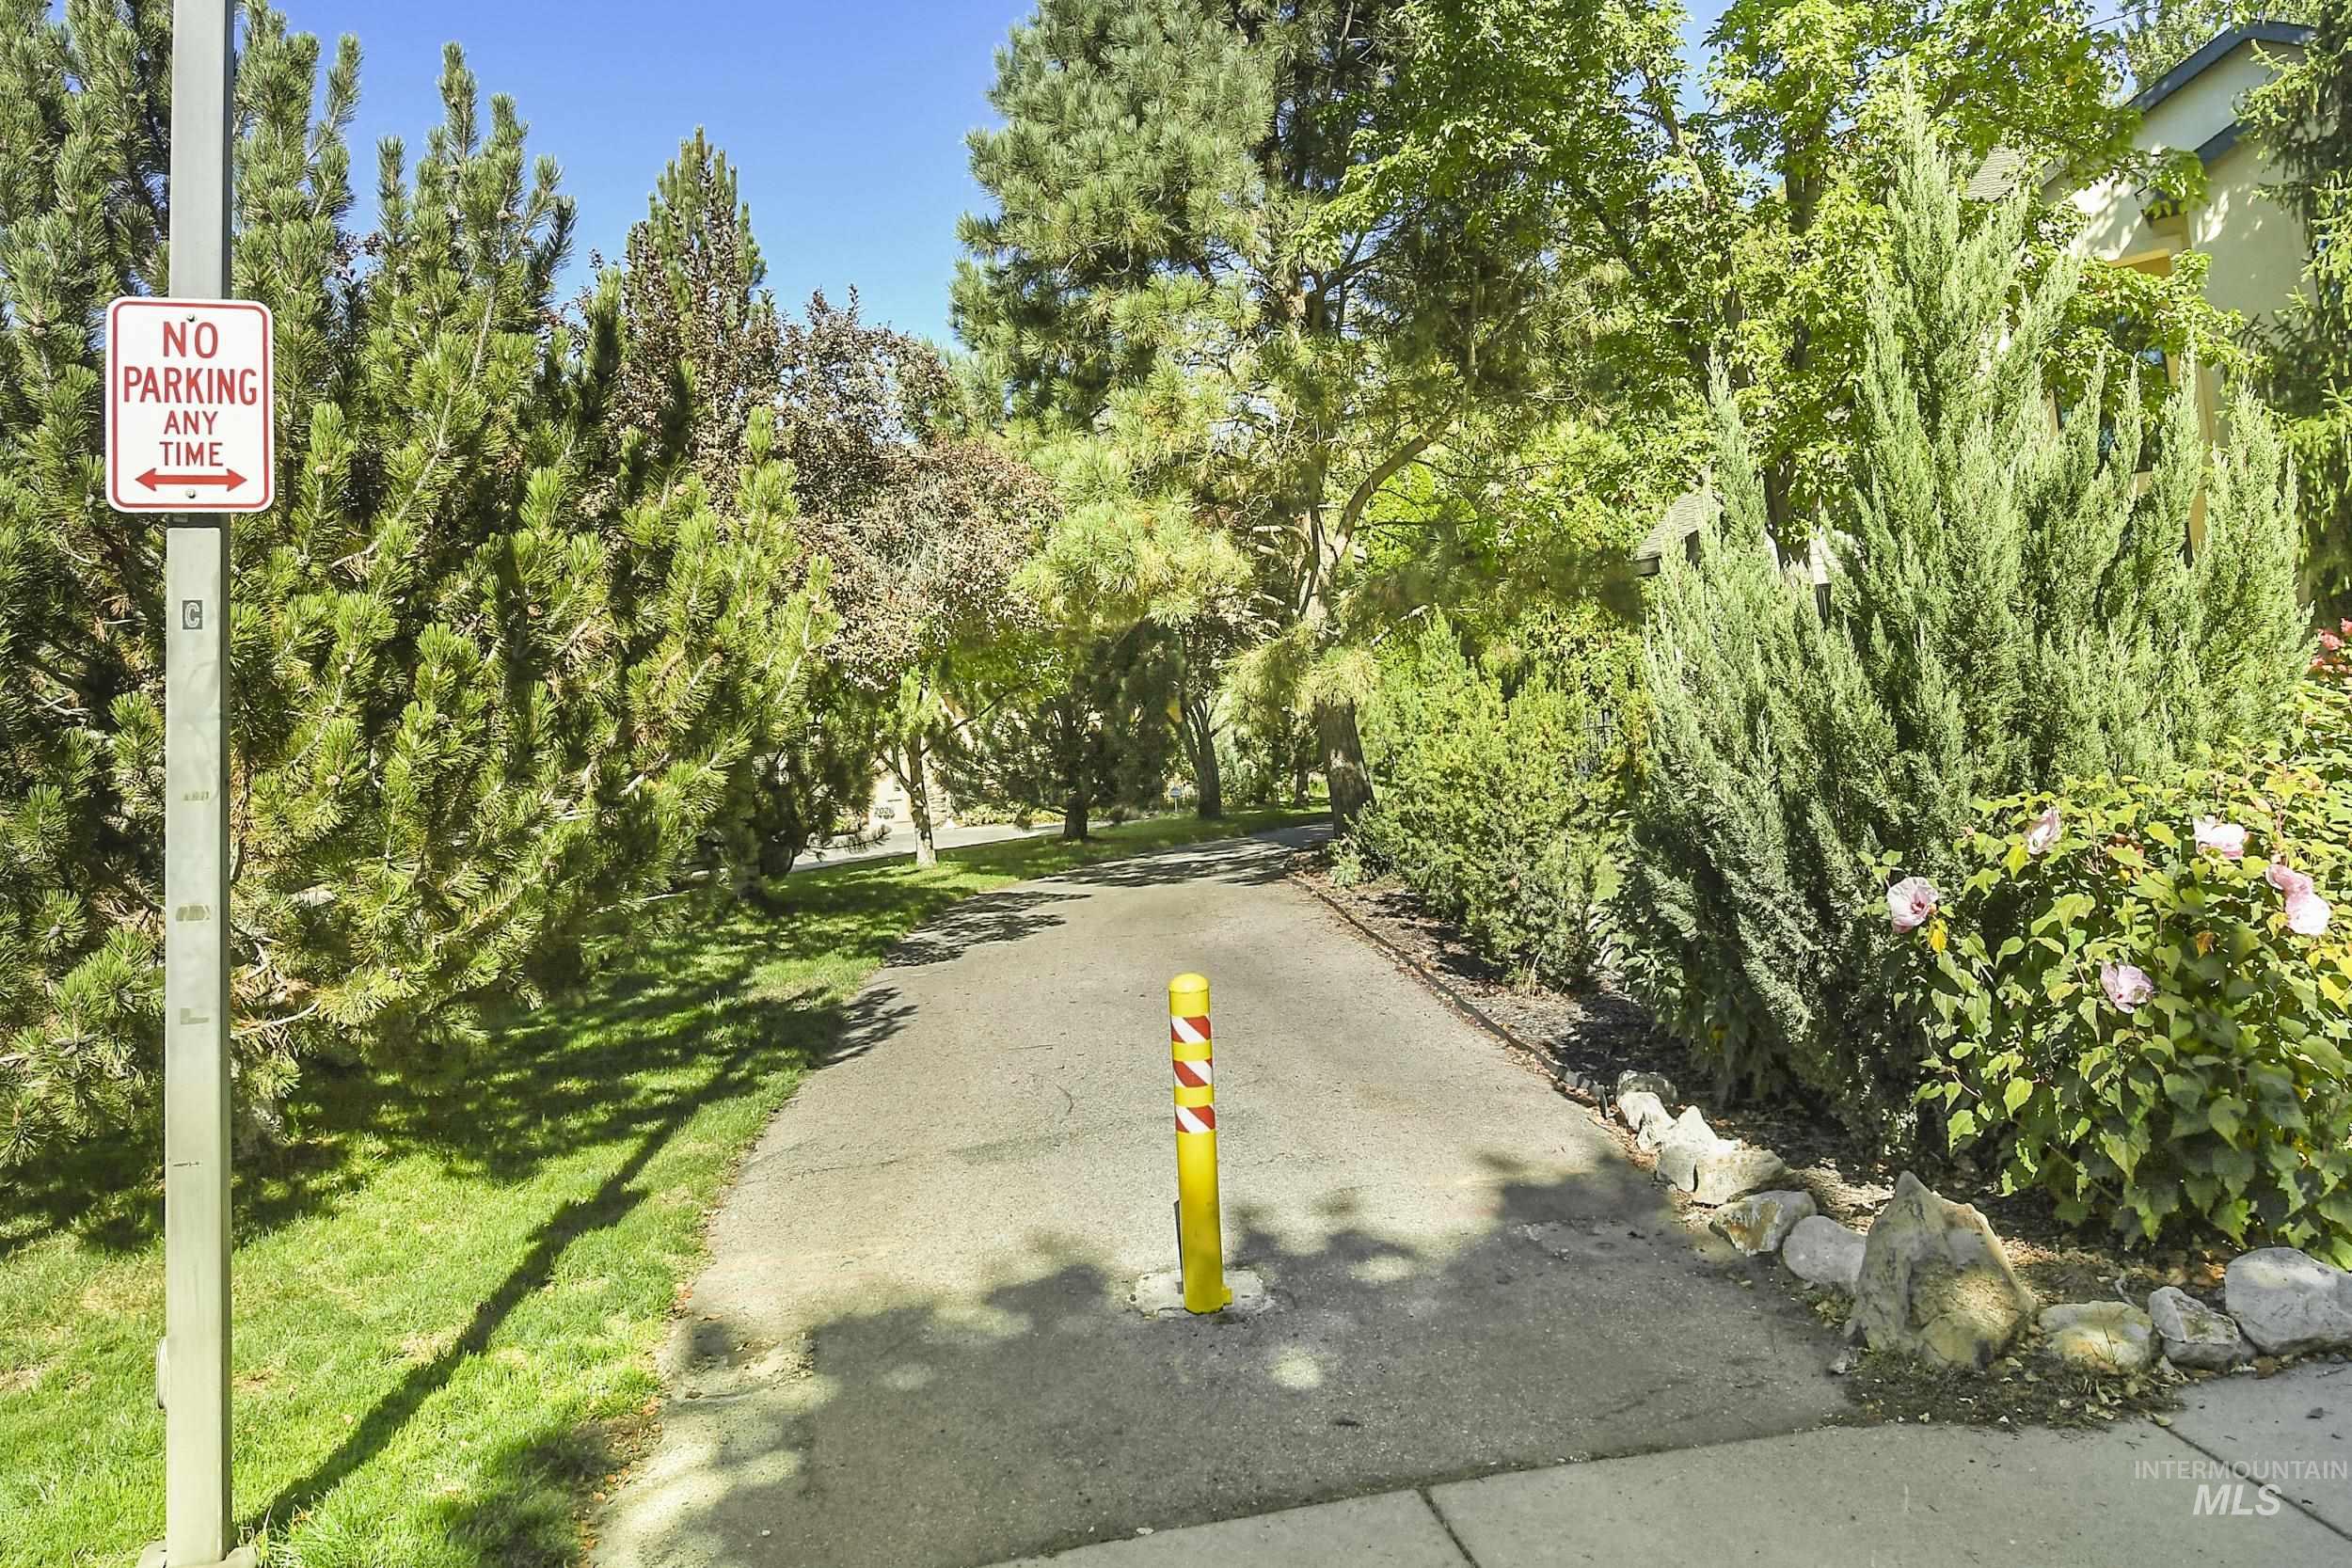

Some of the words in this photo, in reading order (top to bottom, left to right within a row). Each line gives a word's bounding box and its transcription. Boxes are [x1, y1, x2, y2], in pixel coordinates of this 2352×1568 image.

[163, 321, 218, 359] NO
[123, 366, 257, 405] PARKING
[164, 410, 218, 436] ANY
[159, 441, 223, 467] TIME
